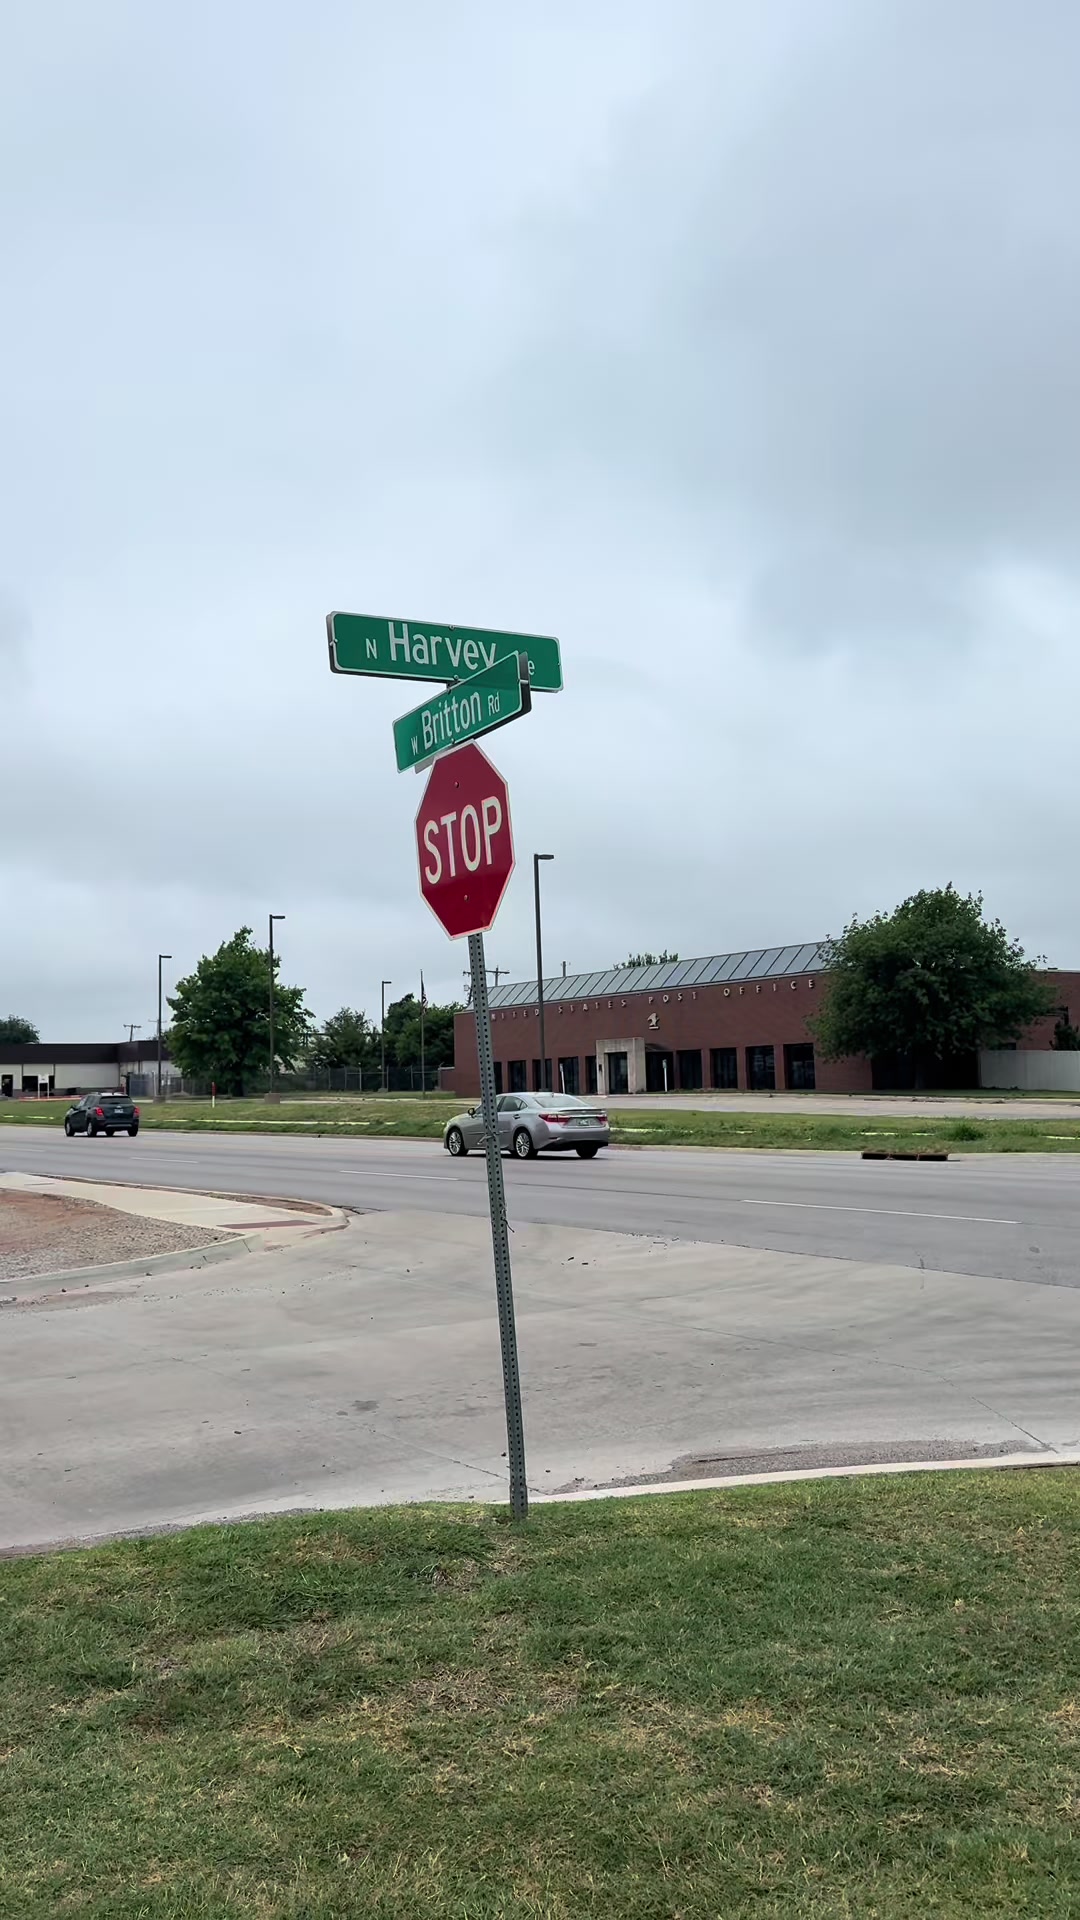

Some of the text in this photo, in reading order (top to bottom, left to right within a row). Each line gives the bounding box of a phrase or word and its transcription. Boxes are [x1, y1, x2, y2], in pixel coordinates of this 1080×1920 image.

[365, 638, 378, 660] N
[388, 621, 497, 670] Harvey
[410, 691, 500, 756] W Britton Rd
[423, 795, 503, 885] STOP
[491, 979, 815, 1020] NITED STATES POST OFFICE
